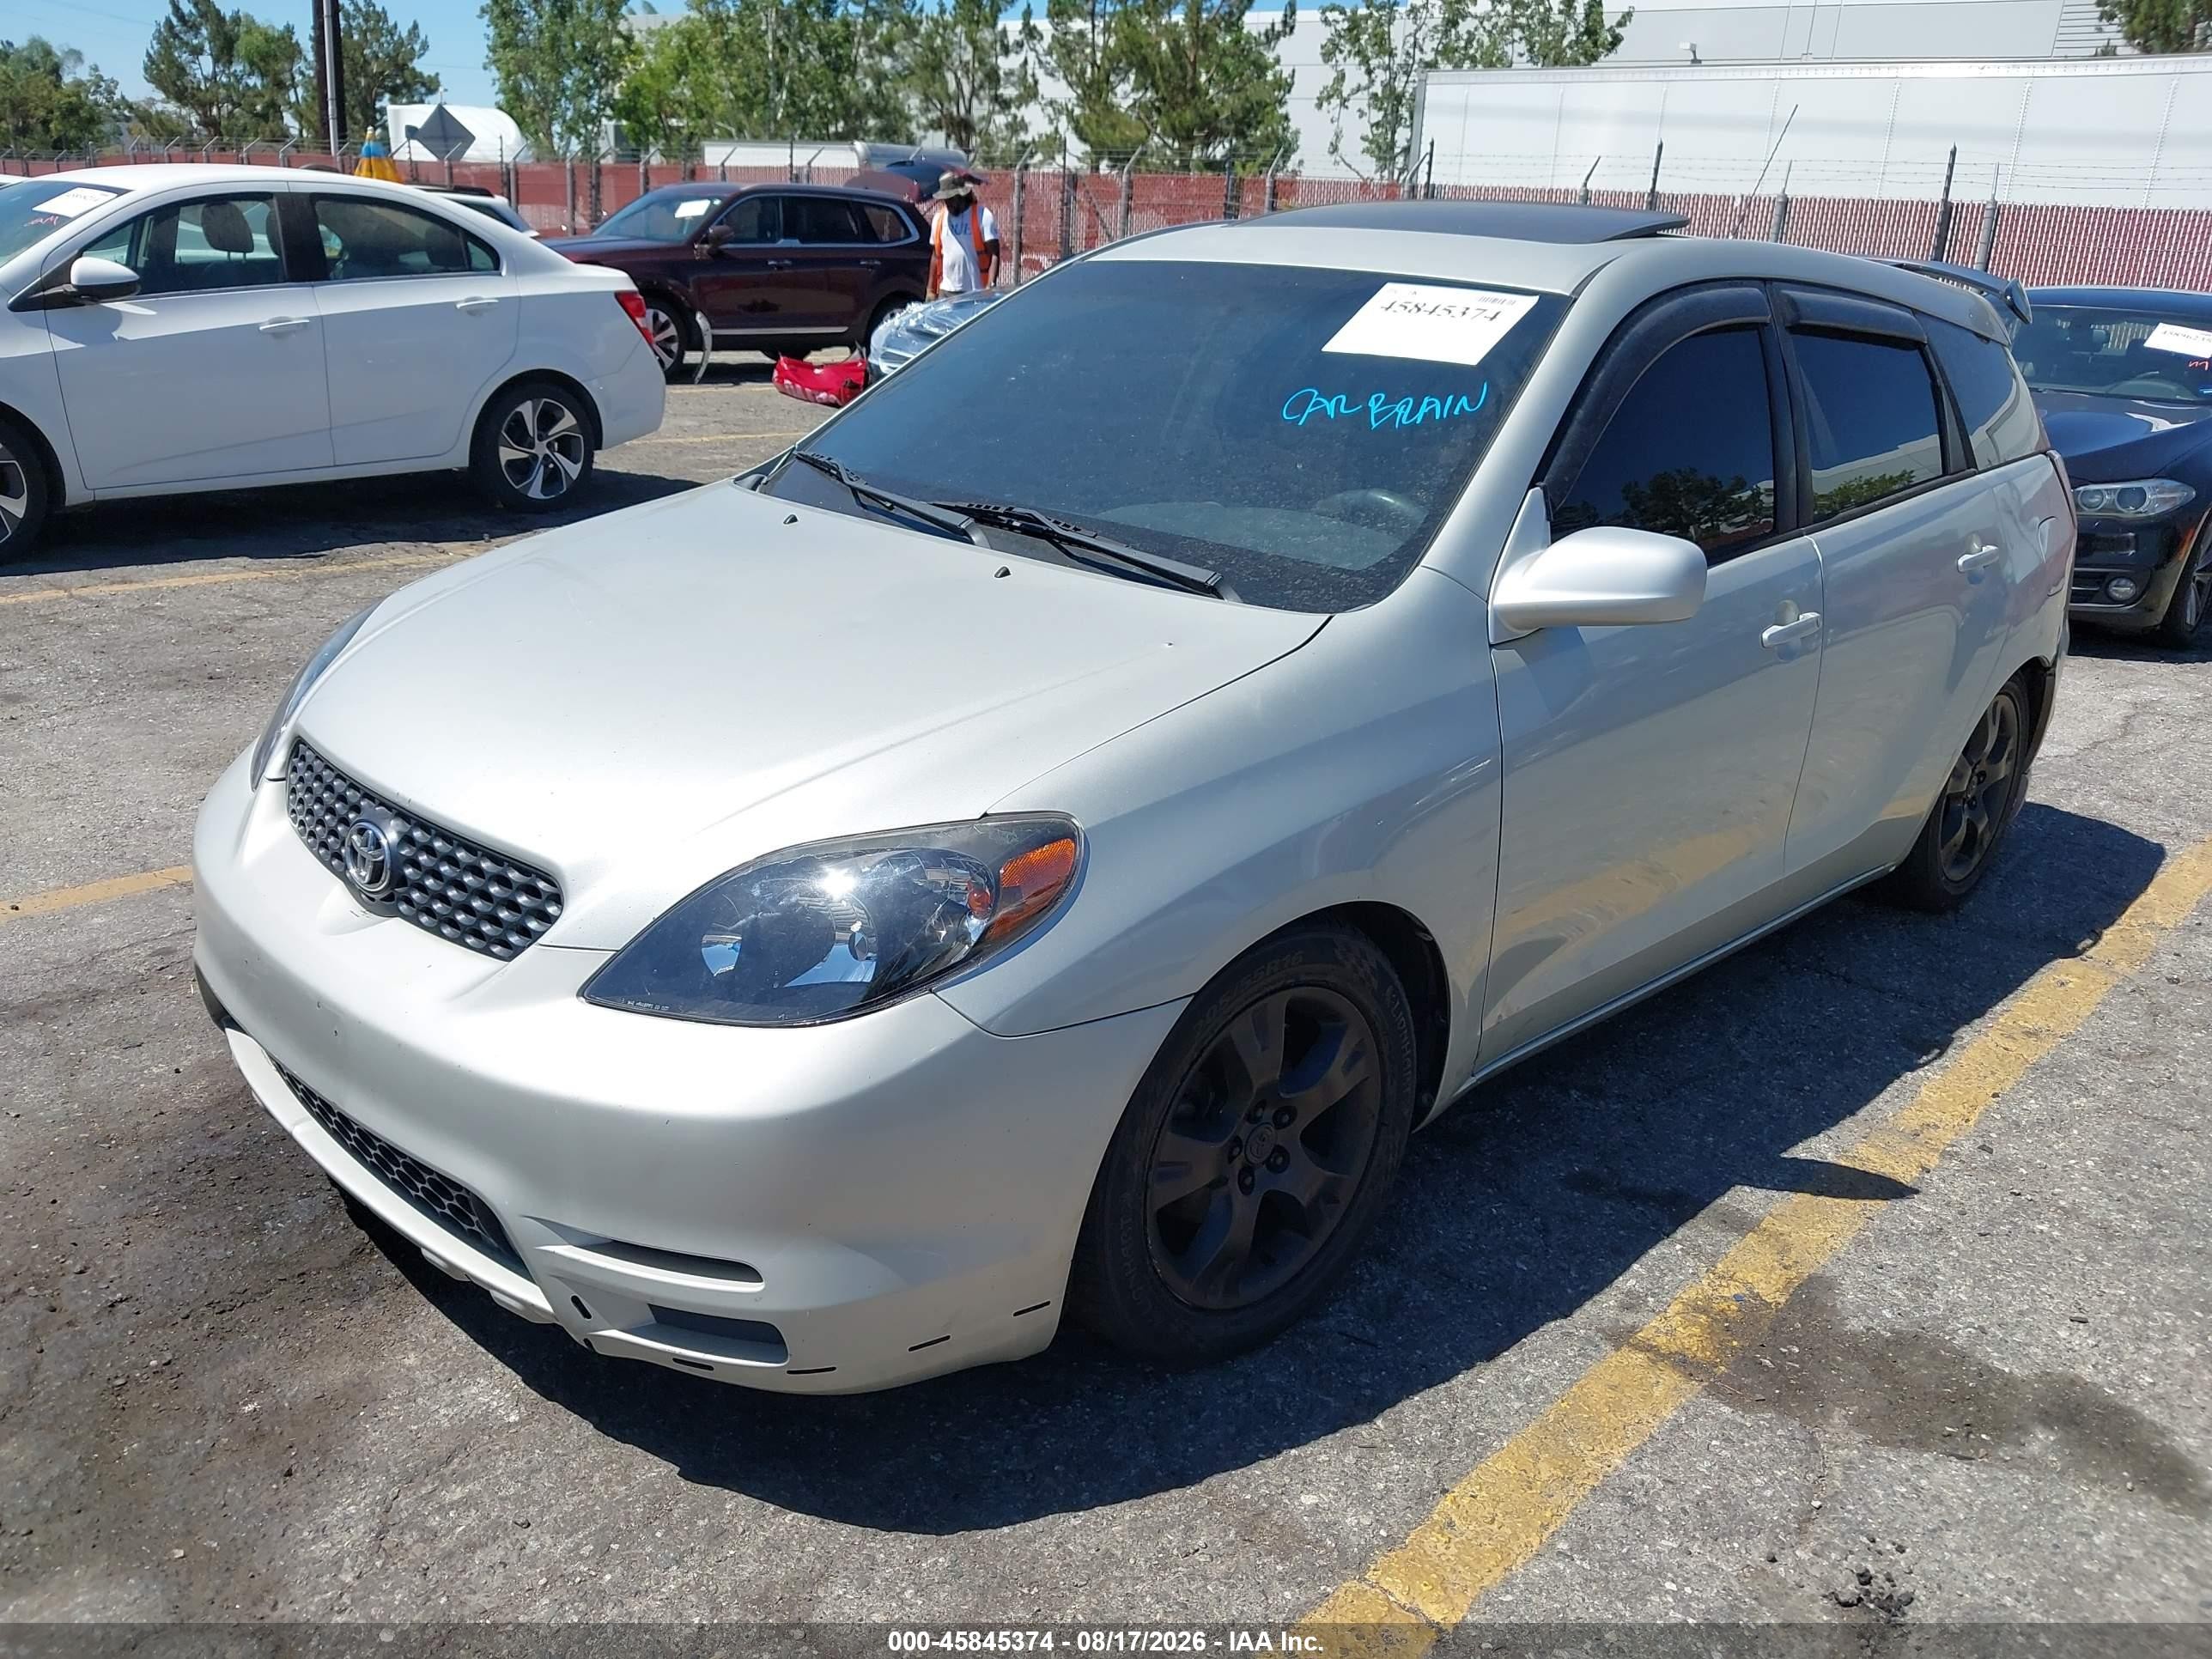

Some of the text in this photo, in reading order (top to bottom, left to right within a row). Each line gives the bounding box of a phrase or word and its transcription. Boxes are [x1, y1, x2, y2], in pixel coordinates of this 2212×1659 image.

[1380, 300, 1502, 322] 45845374
[1282, 381, 1488, 430] CAR BRAIN
